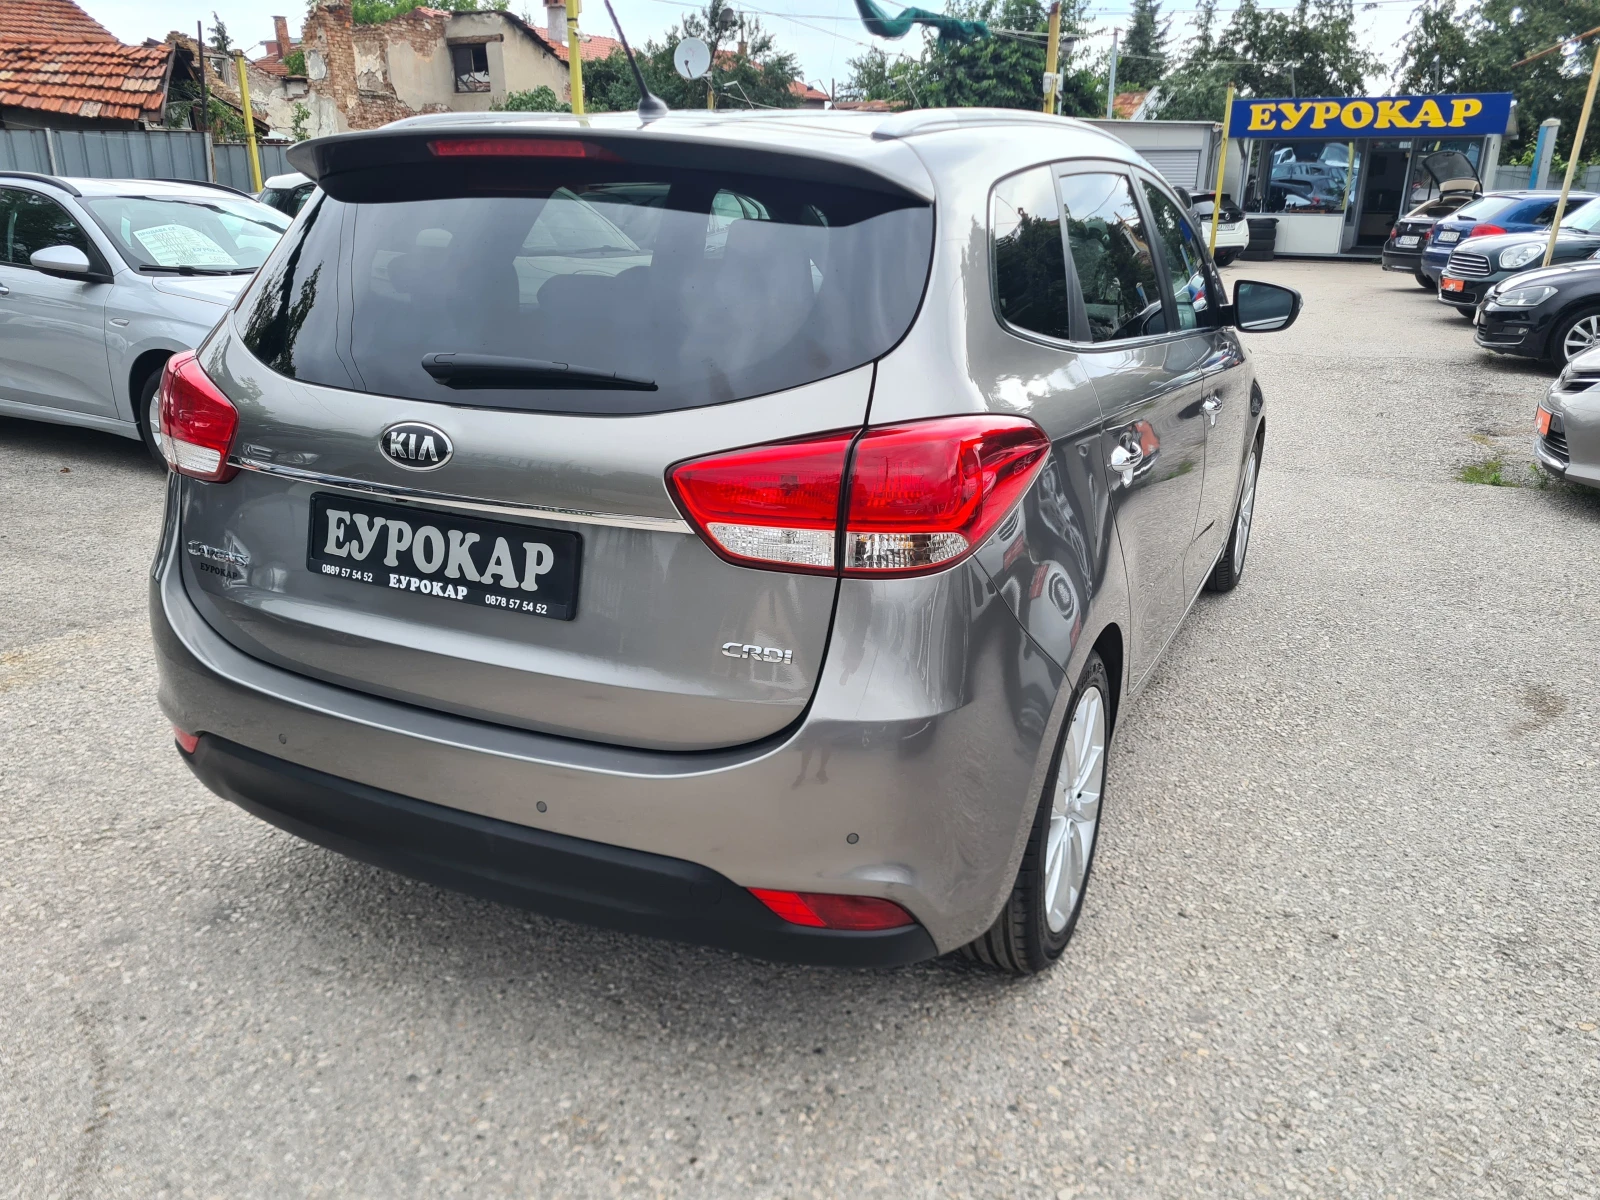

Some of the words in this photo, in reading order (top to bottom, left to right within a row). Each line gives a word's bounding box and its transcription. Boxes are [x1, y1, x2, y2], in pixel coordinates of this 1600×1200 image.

[1247, 98, 1483, 131] ЕУРОКАР
[390, 431, 439, 462] KIA
[323, 508, 555, 592] ЕУРОКАР
[200, 562, 238, 579] ЕУРОКАР
[322, 564, 340, 576] 0889
[341, 567, 351, 578] 57
[351, 570, 362, 581] 54
[363, 572, 373, 583] 52
[388, 573, 468, 600] ЕУРОКАР
[485, 594, 507, 607] 0878
[508, 599, 520, 609] 57
[522, 601, 534, 612] 54
[535, 603, 548, 615] 52
